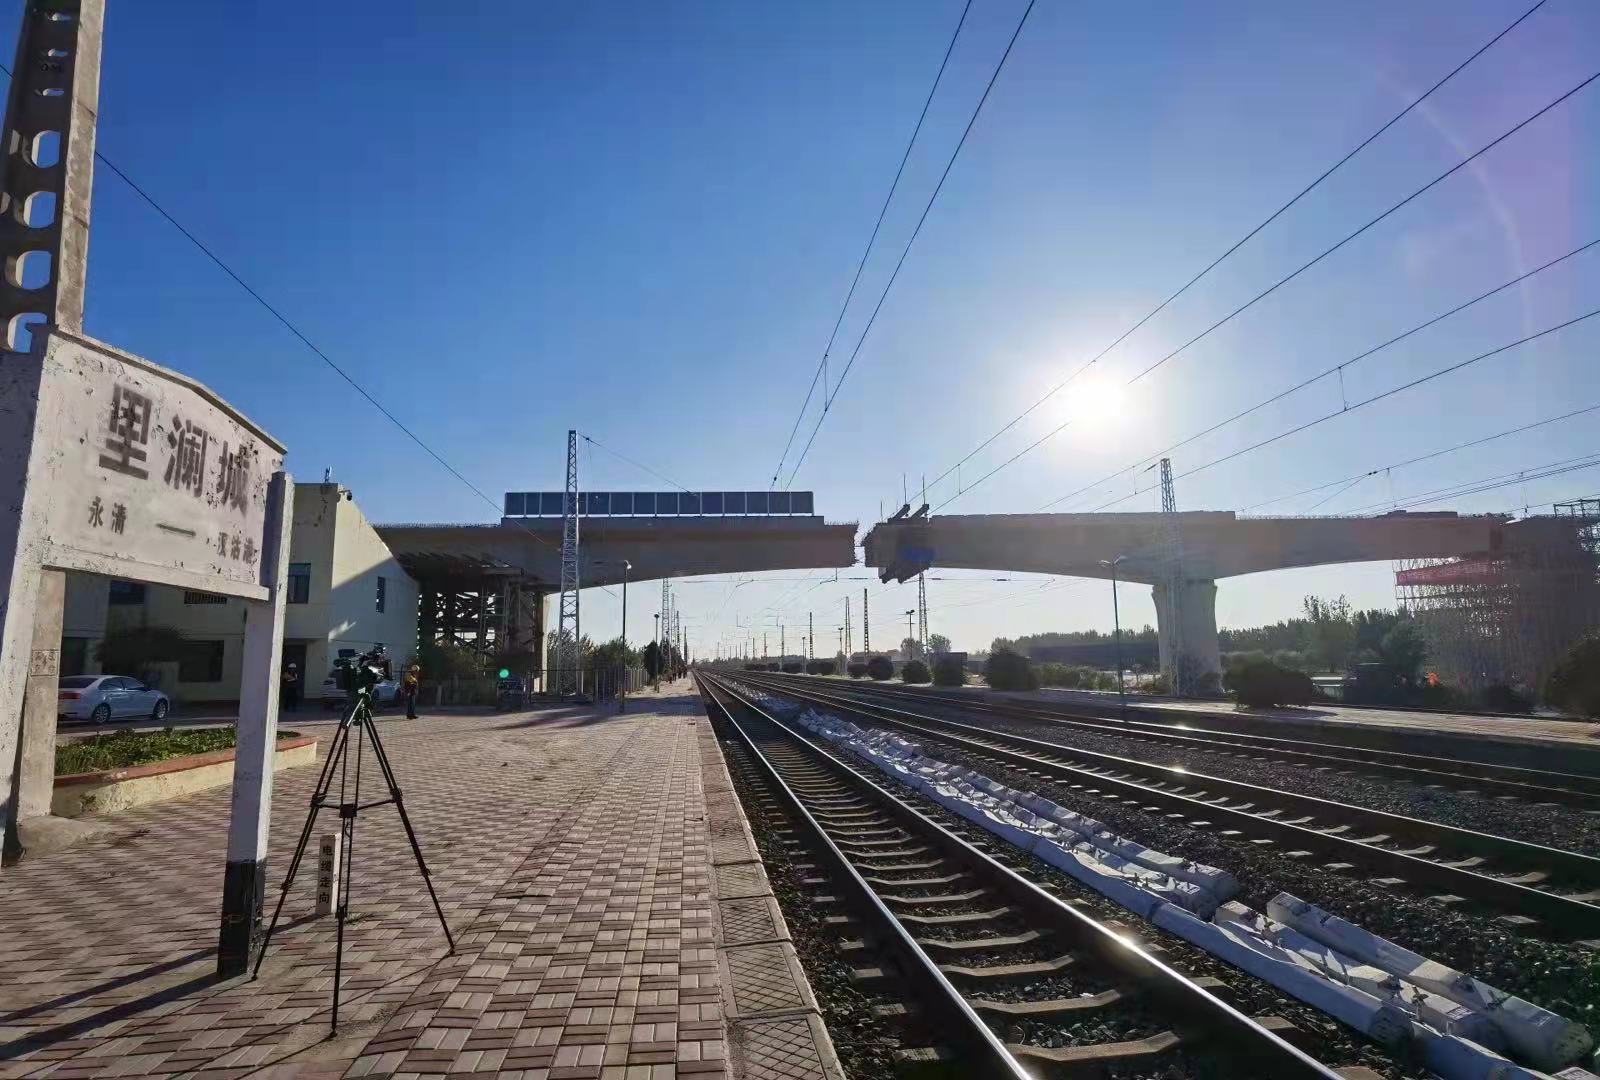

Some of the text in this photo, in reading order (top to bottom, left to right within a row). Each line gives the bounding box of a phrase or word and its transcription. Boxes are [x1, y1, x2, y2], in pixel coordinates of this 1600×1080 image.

[88, 496, 127, 535] 永清
[320, 845, 334, 905] 电缆走向
